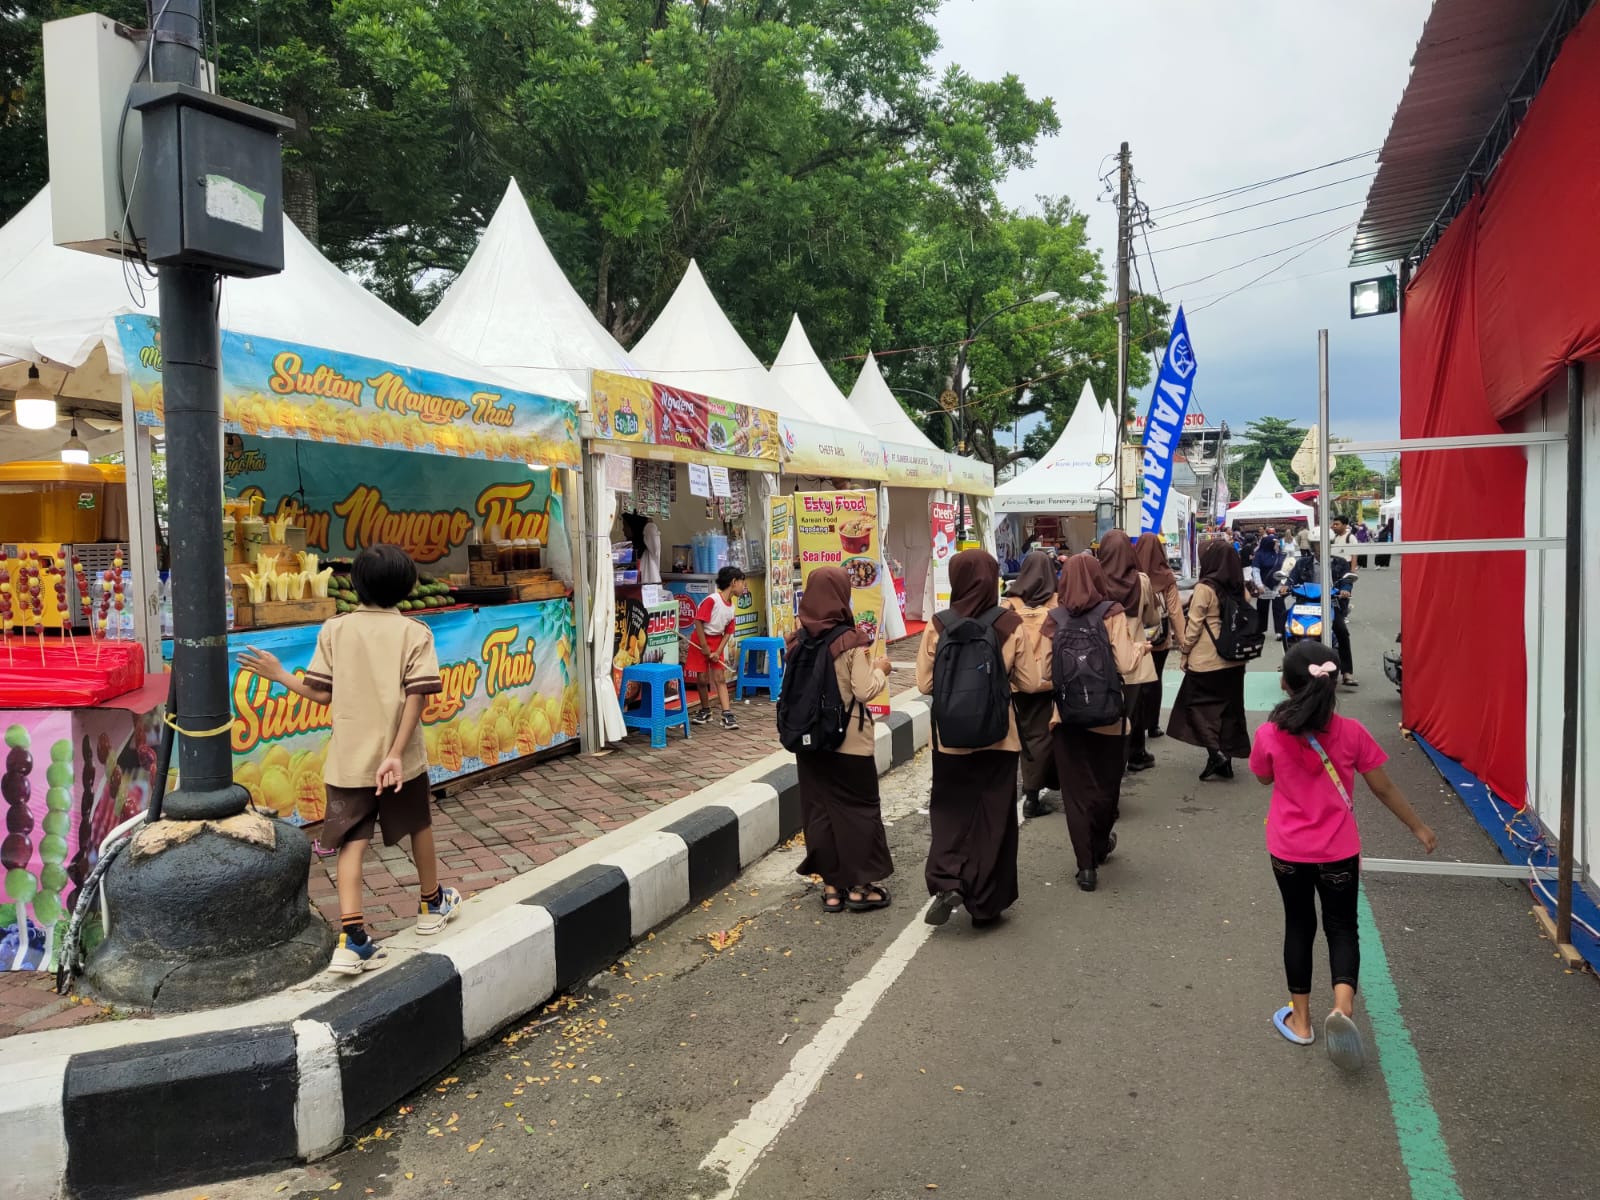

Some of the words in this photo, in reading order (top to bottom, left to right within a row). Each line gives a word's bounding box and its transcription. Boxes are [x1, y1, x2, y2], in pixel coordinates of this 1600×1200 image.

[270, 352, 361, 406] Sultan
[366, 371, 470, 424] Manggo
[471, 392, 514, 426] Thai
[1184, 413, 1205, 426] STO
[1141, 380, 1186, 530] YAMAHA
[333, 483, 475, 563] Manggo
[476, 480, 550, 548] Thai
[803, 496, 833, 515] Esty
[835, 496, 867, 511] Food
[933, 503, 954, 520] cheers
[803, 551, 819, 562] Sea
[231, 668, 333, 753] Sulta
[422, 658, 481, 724] ggo
[483, 625, 535, 697] Thai
